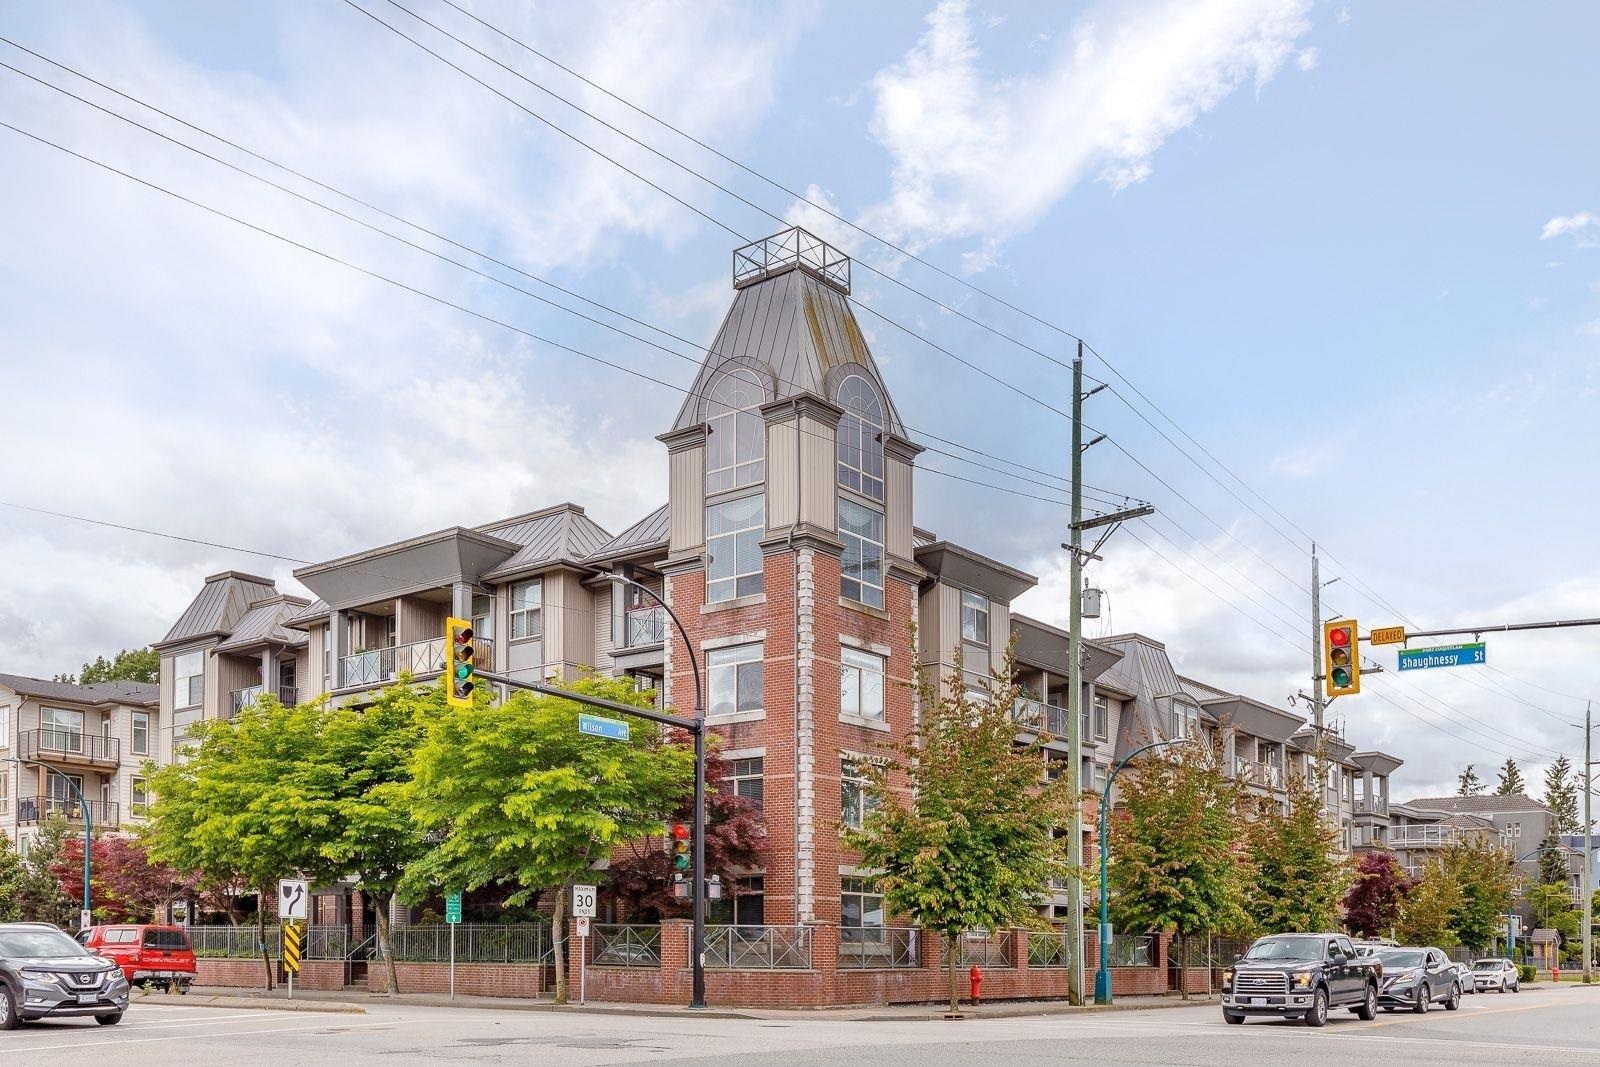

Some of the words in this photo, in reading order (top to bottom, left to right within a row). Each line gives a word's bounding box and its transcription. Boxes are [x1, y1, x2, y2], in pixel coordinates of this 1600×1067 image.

[1373, 629, 1402, 643] DELAYED
[1402, 654, 1459, 669] Shaughnessy
[1474, 650, 1484, 662] St
[582, 721, 603, 733] Wilson
[576, 894, 593, 908] 30
